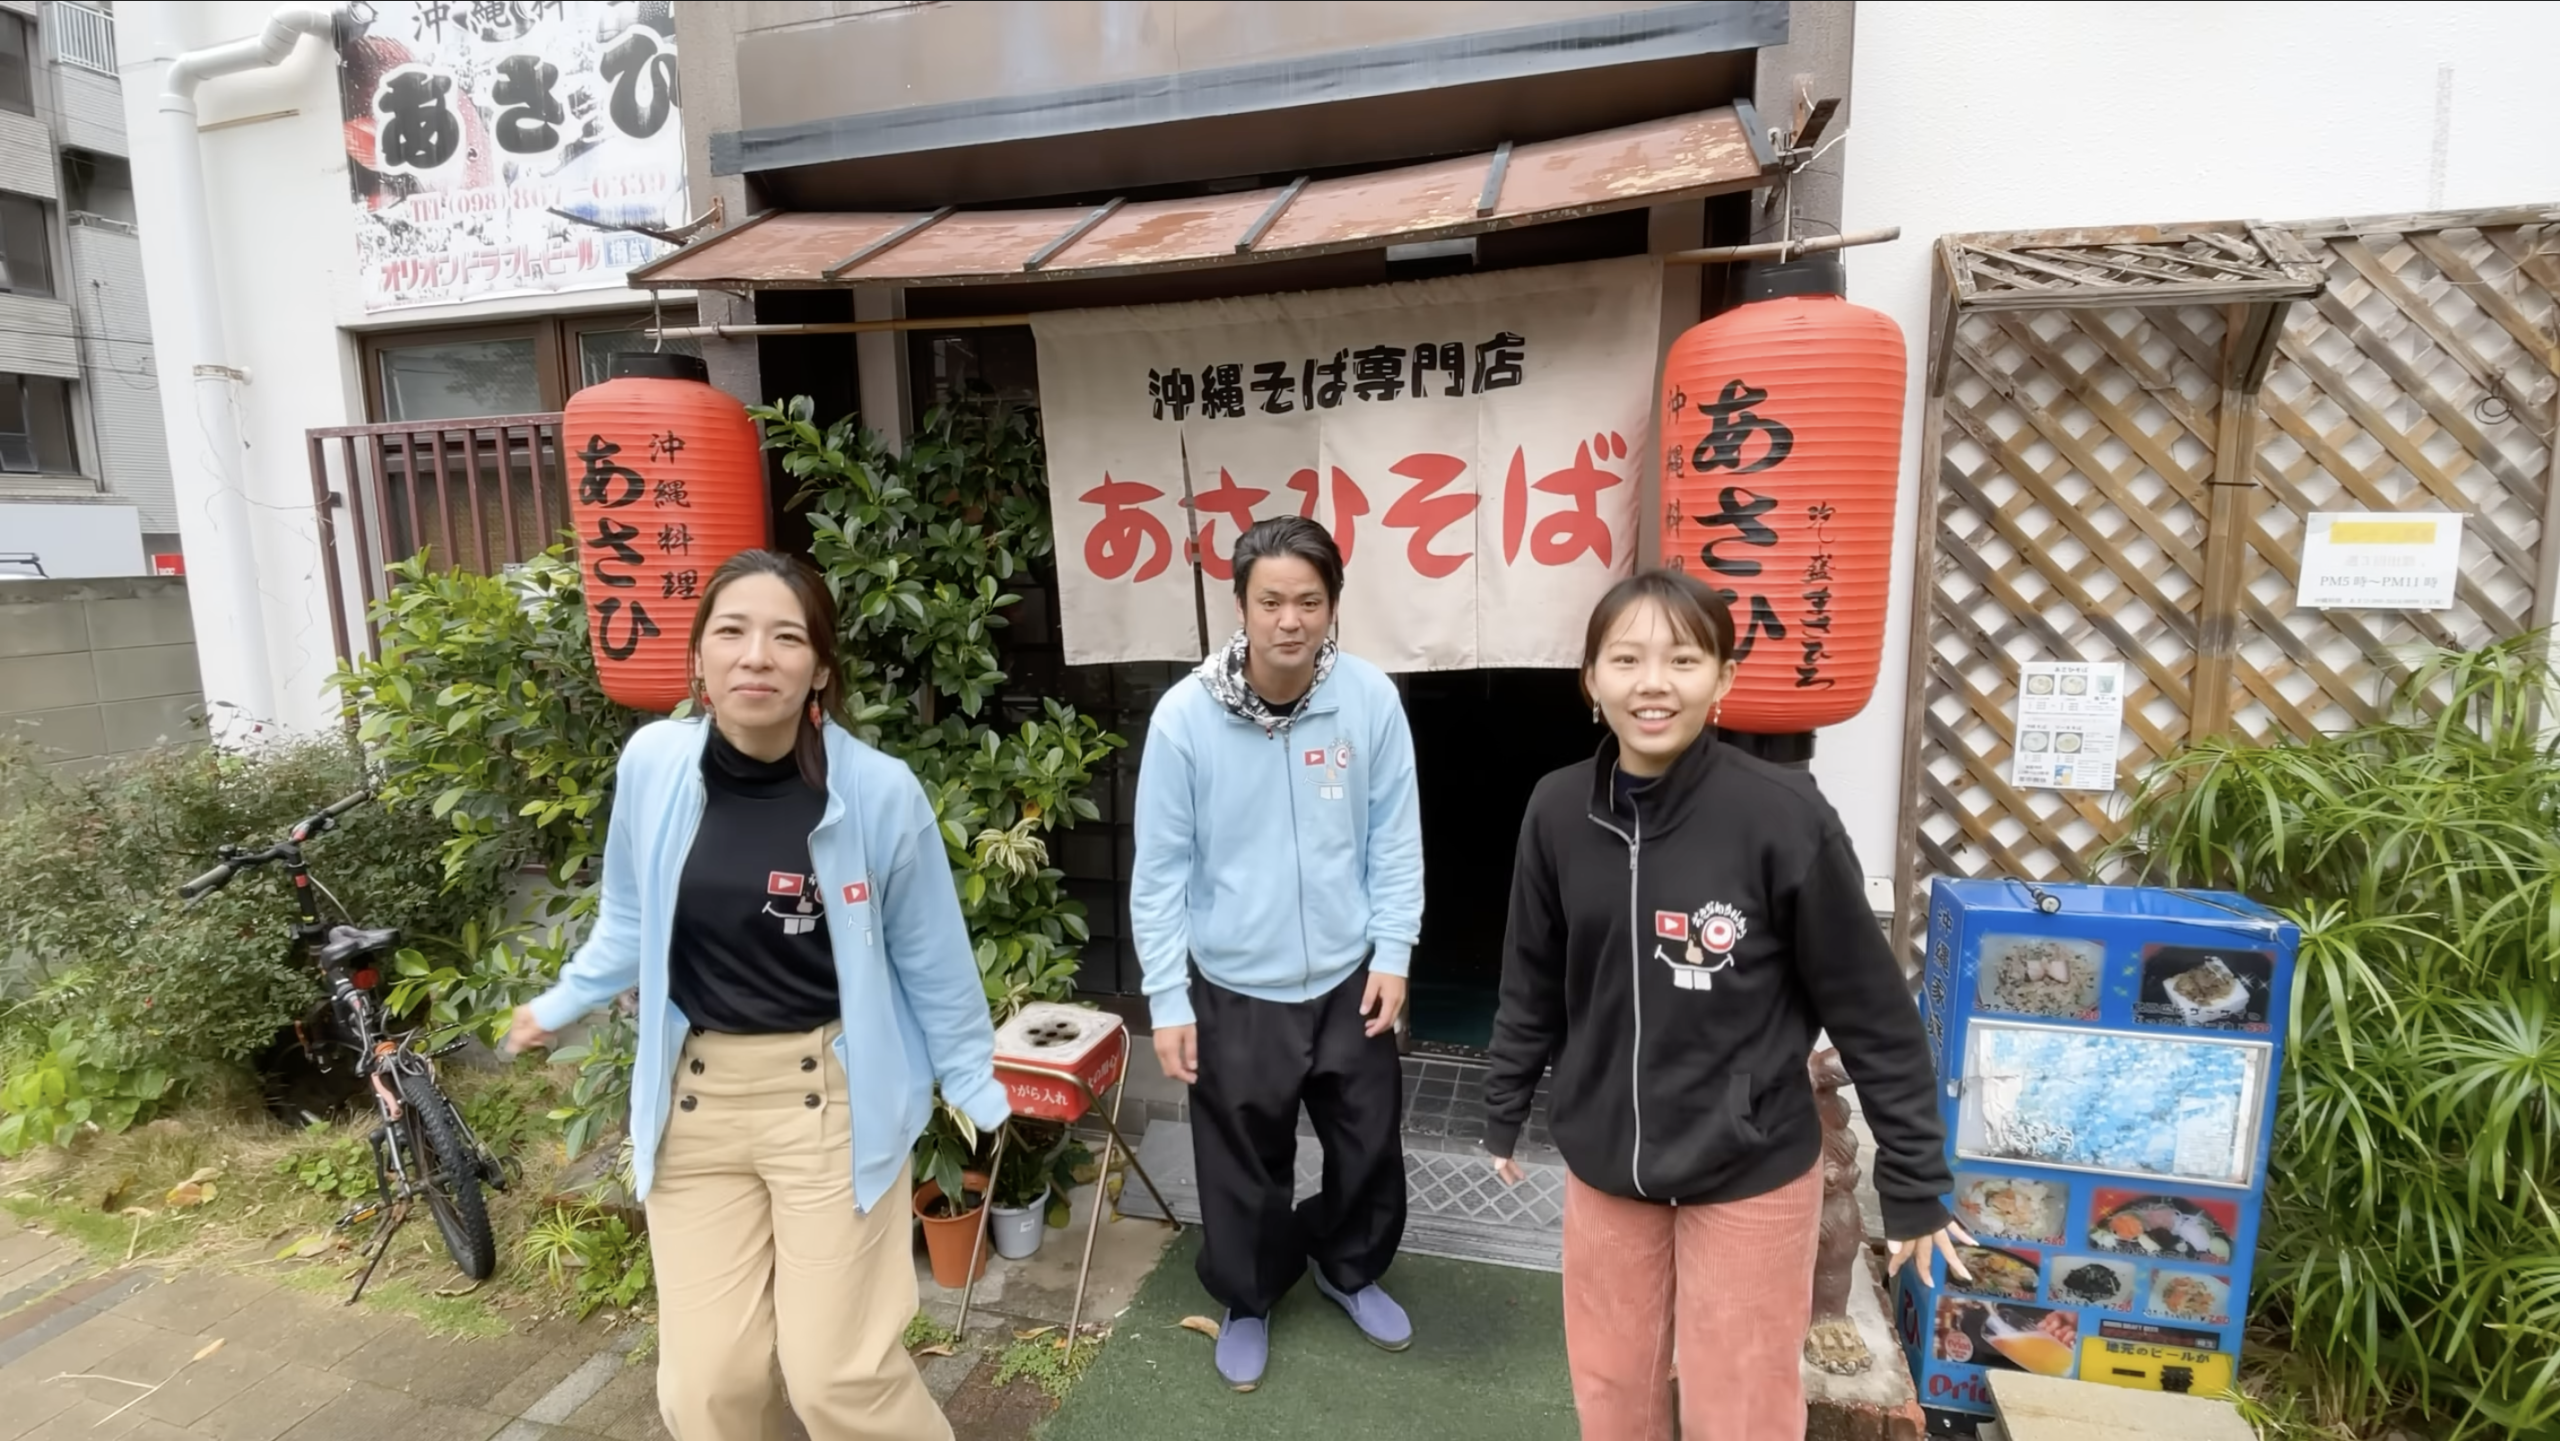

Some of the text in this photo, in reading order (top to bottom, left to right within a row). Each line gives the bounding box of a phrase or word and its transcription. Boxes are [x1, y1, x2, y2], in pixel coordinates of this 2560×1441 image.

[378, 33, 678, 169] あさひ
[381, 236, 600, 292] オリオンドラフトビール
[1148, 331, 1526, 422] 沖縄そば専門店
[576, 434, 661, 661] あさひ
[649, 430, 700, 600] 沖縄料理
[1078, 431, 1628, 583] あさひそば
[1691, 379, 1794, 664] あさひ
[2106, 1340, 2210, 1364] 地元のビールが
